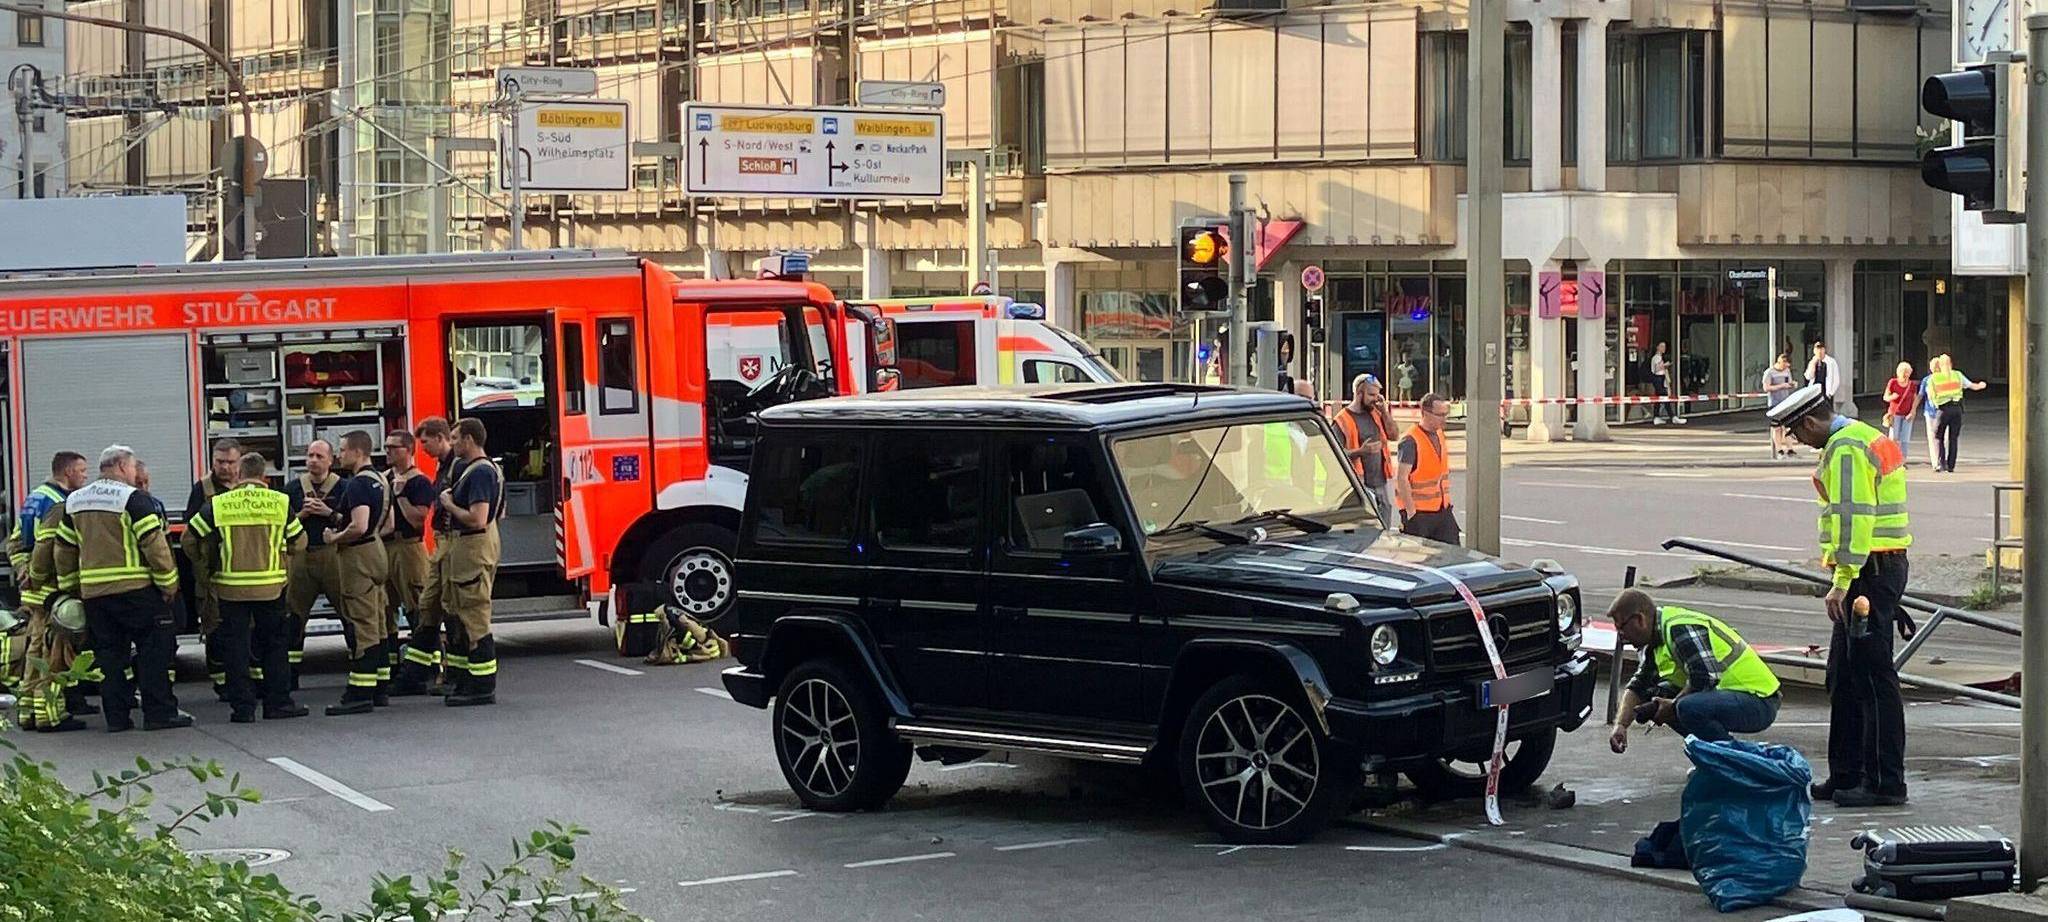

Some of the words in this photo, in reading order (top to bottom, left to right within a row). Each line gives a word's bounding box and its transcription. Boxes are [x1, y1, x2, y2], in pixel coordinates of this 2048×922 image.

[520, 75, 562, 86] City-Ring
[891, 90, 927, 100] City-Ring
[539, 112, 594, 126] Böblingen
[746, 119, 812, 133] Ludwigsburg
[857, 122, 910, 135] Waiblingen
[537, 147, 614, 160] Wilhelmsplatz
[742, 160, 777, 171] Schloß
[853, 159, 881, 169] S-Ost
[853, 173, 910, 184] Kulturmeile
[182, 292, 337, 324] STUTTGART
[579, 449, 593, 480] 112
